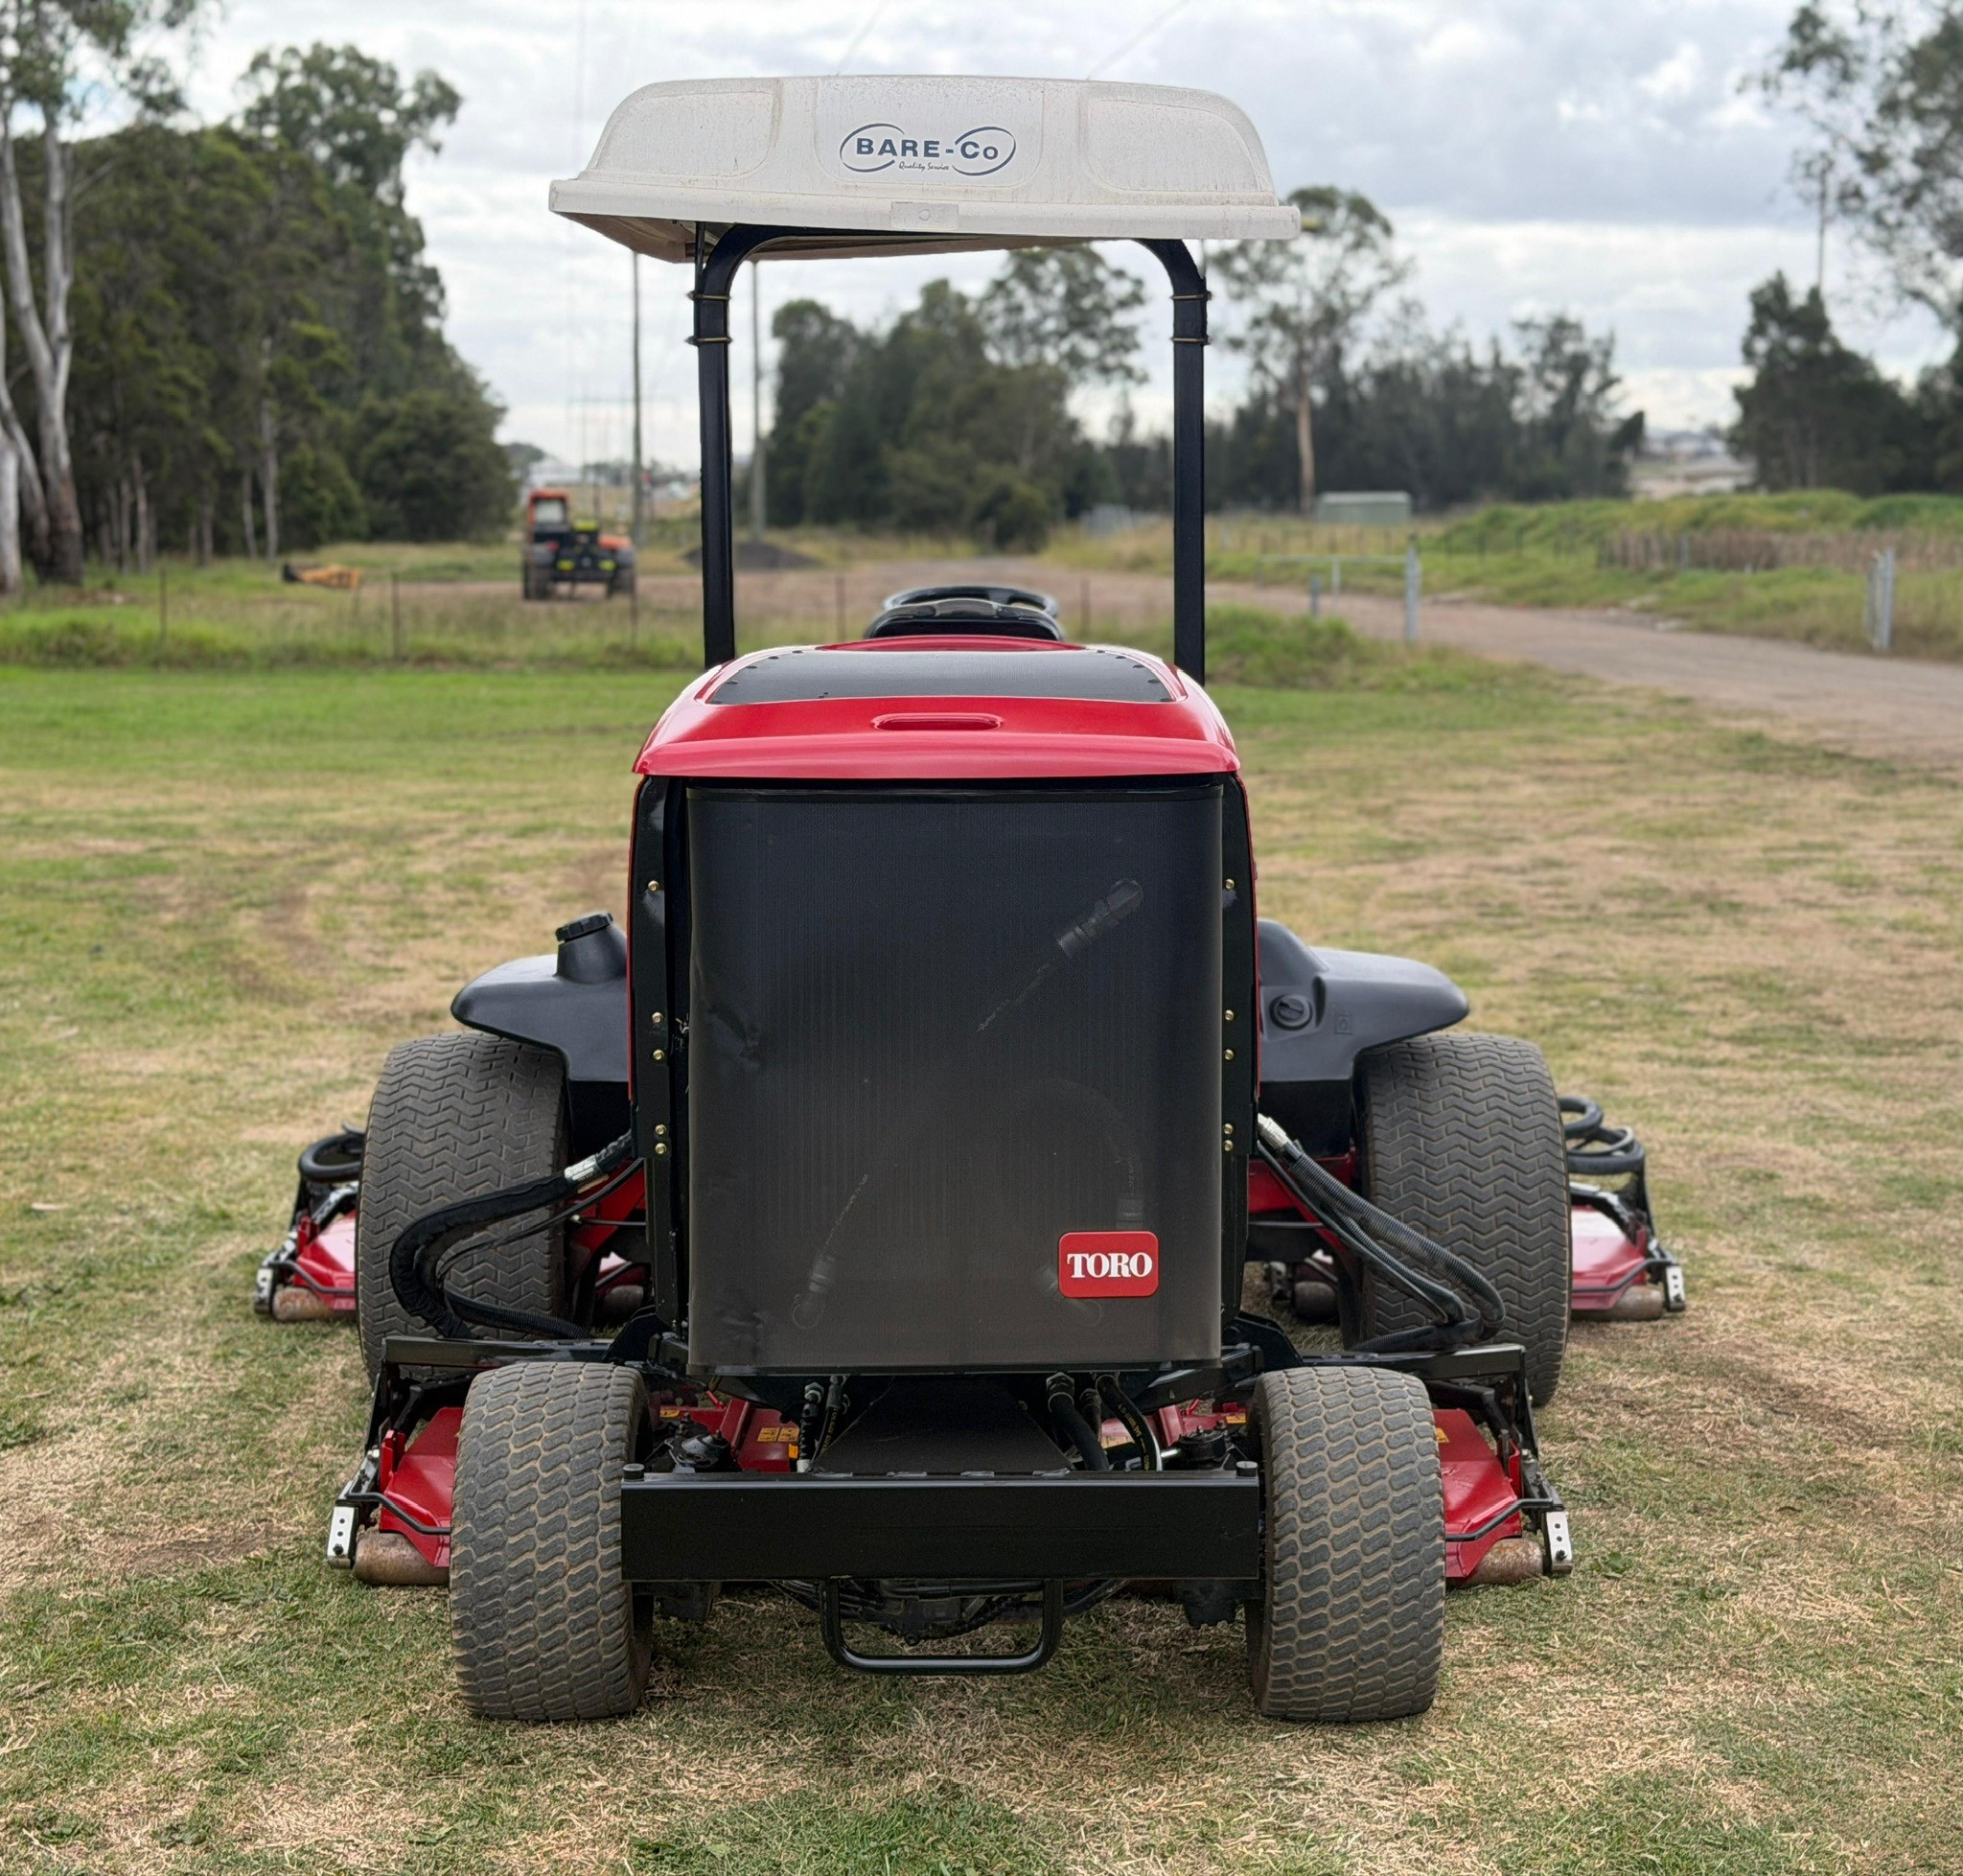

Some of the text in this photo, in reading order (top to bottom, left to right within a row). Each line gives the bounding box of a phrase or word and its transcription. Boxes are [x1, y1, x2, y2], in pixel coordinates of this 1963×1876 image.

[856, 137, 999, 160] BARE-Co
[899, 160, 950, 173] Quality Service
[1067, 1252, 1153, 1279] TORO
